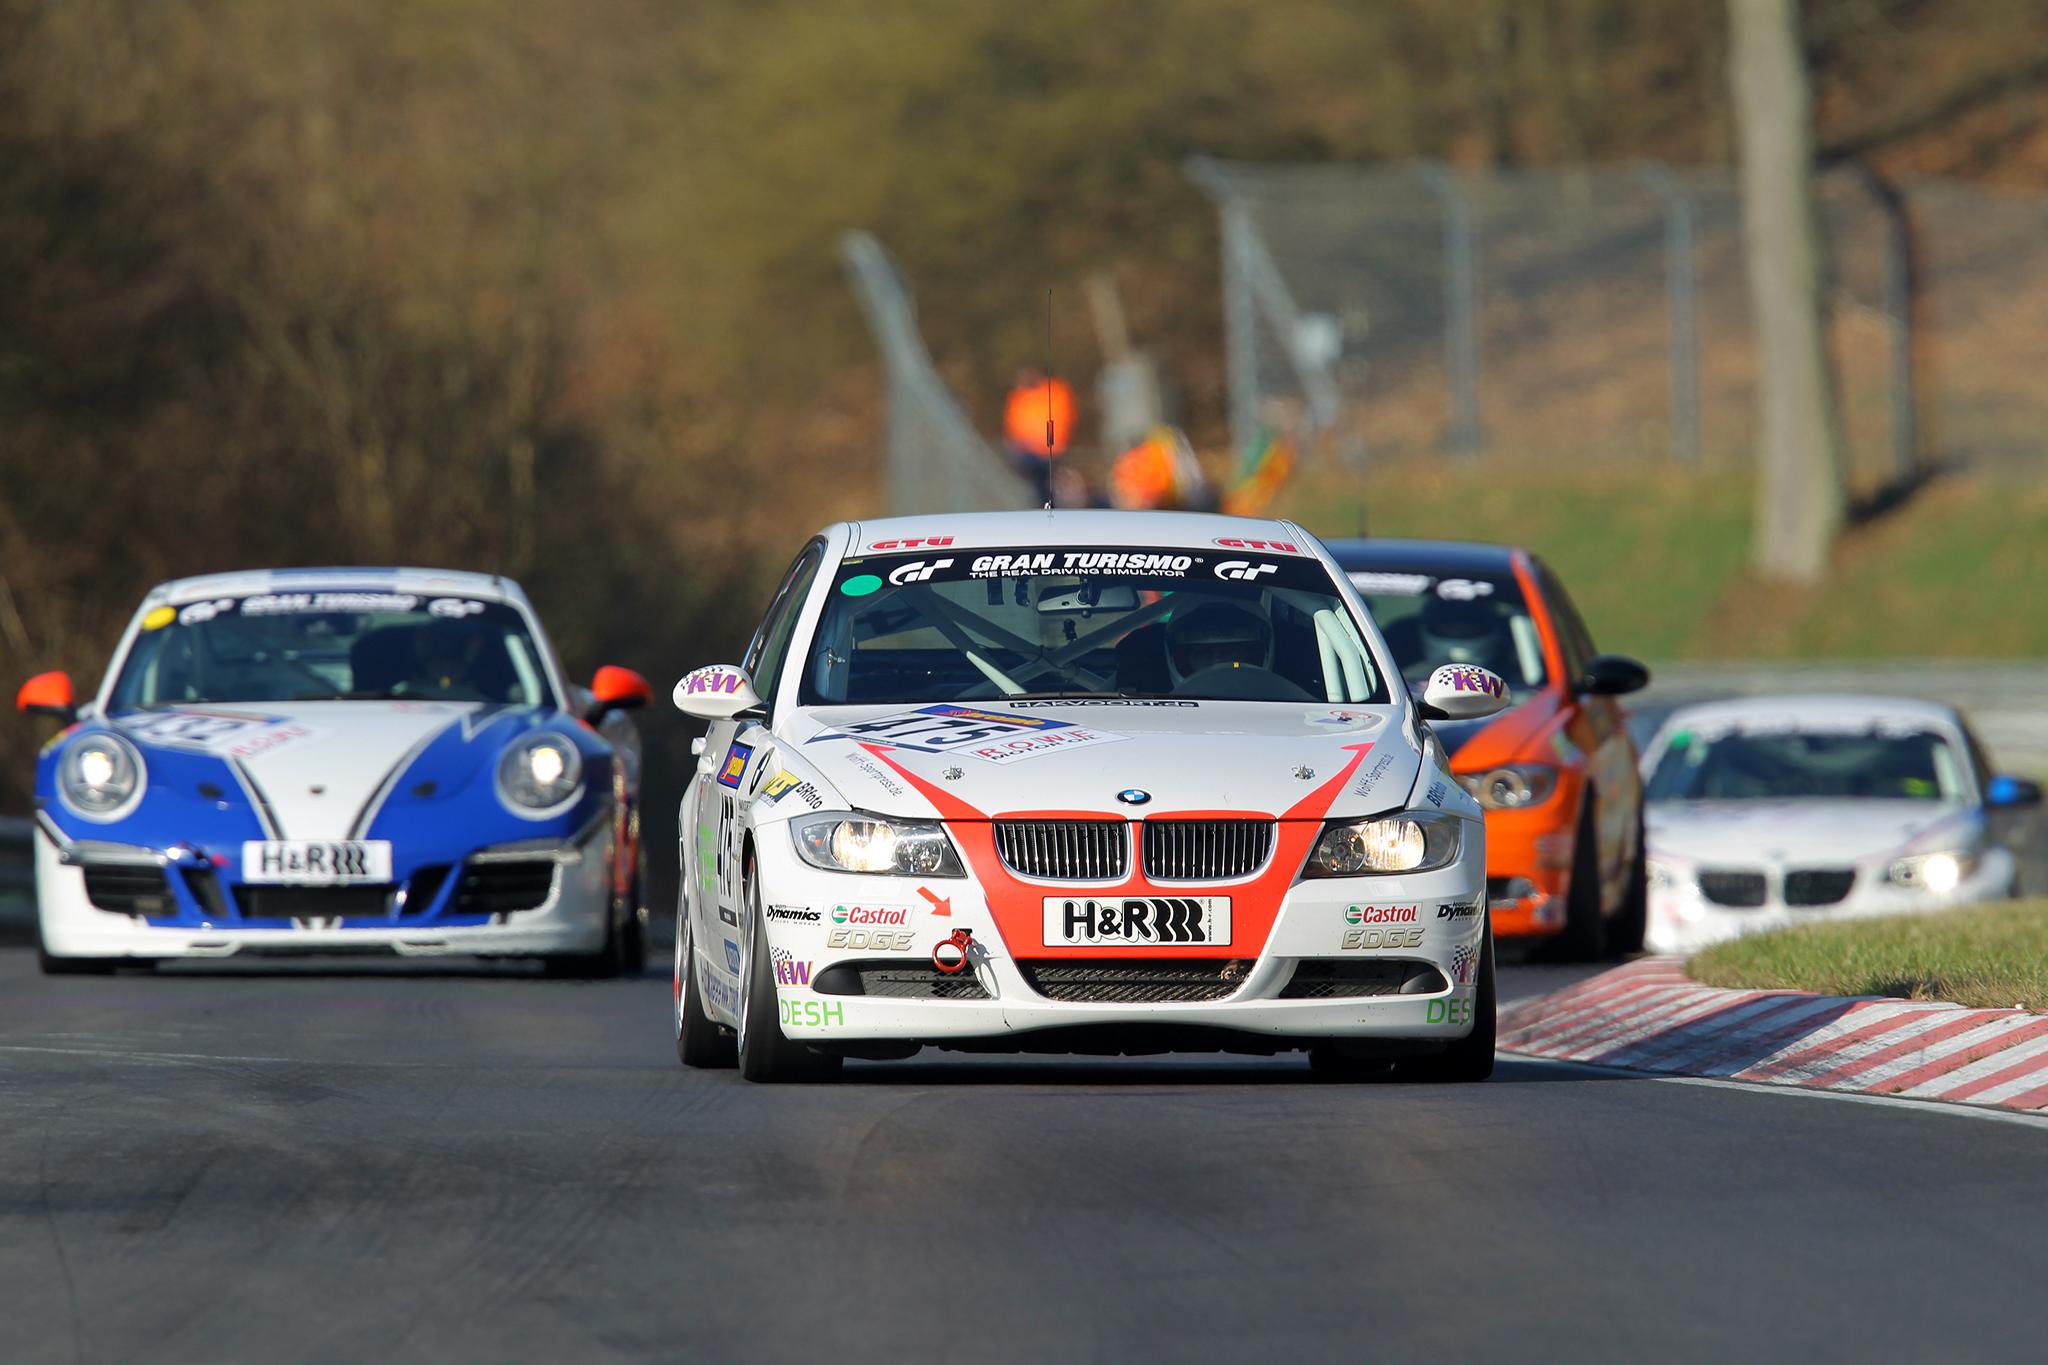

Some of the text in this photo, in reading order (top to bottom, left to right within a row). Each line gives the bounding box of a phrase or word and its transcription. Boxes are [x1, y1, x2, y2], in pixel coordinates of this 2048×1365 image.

[888, 558, 954, 585] GT
[971, 553, 1192, 571] GRAN TURISMO
[1215, 560, 1278, 581] GT
[969, 568, 1185, 579] THE REAL DRIVING SIMULATOR
[686, 671, 746, 695] KW
[1452, 671, 1504, 699] KW
[977, 729, 1090, 758] ROWE
[991, 741, 1057, 760] MOTOR
[766, 904, 822, 922] Dynamics
[849, 905, 907, 925] Castrol
[1063, 899, 1160, 943] H&R
[1362, 904, 1417, 924] Castrol
[1437, 904, 1478, 921] Dyna
[827, 928, 916, 951] EDGE
[1341, 928, 1426, 950] EDGE
[776, 960, 813, 985] KW
[781, 999, 844, 1027] DESH
